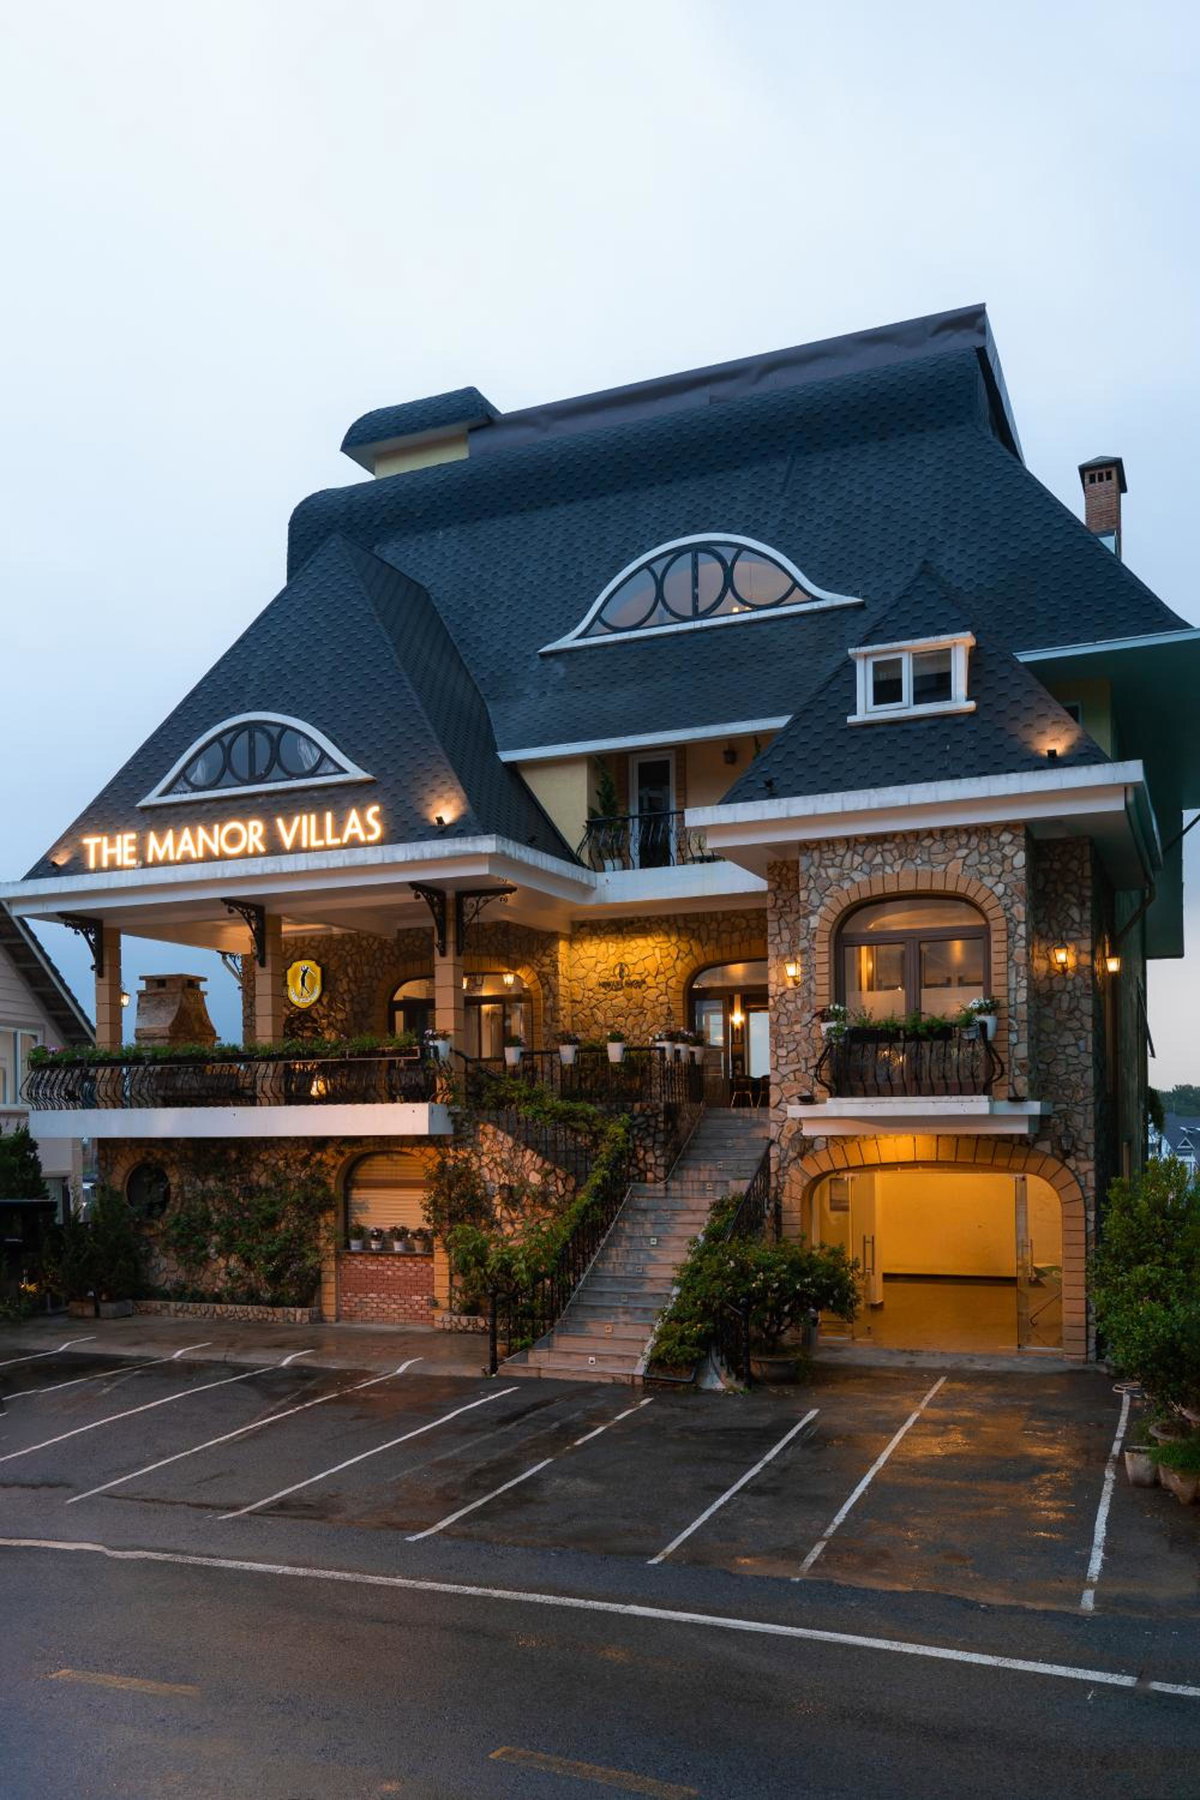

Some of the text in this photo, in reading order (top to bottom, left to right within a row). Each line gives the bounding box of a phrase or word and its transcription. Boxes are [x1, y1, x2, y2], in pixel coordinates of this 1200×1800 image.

[82, 805, 383, 869] THE MANOR VILLAS
